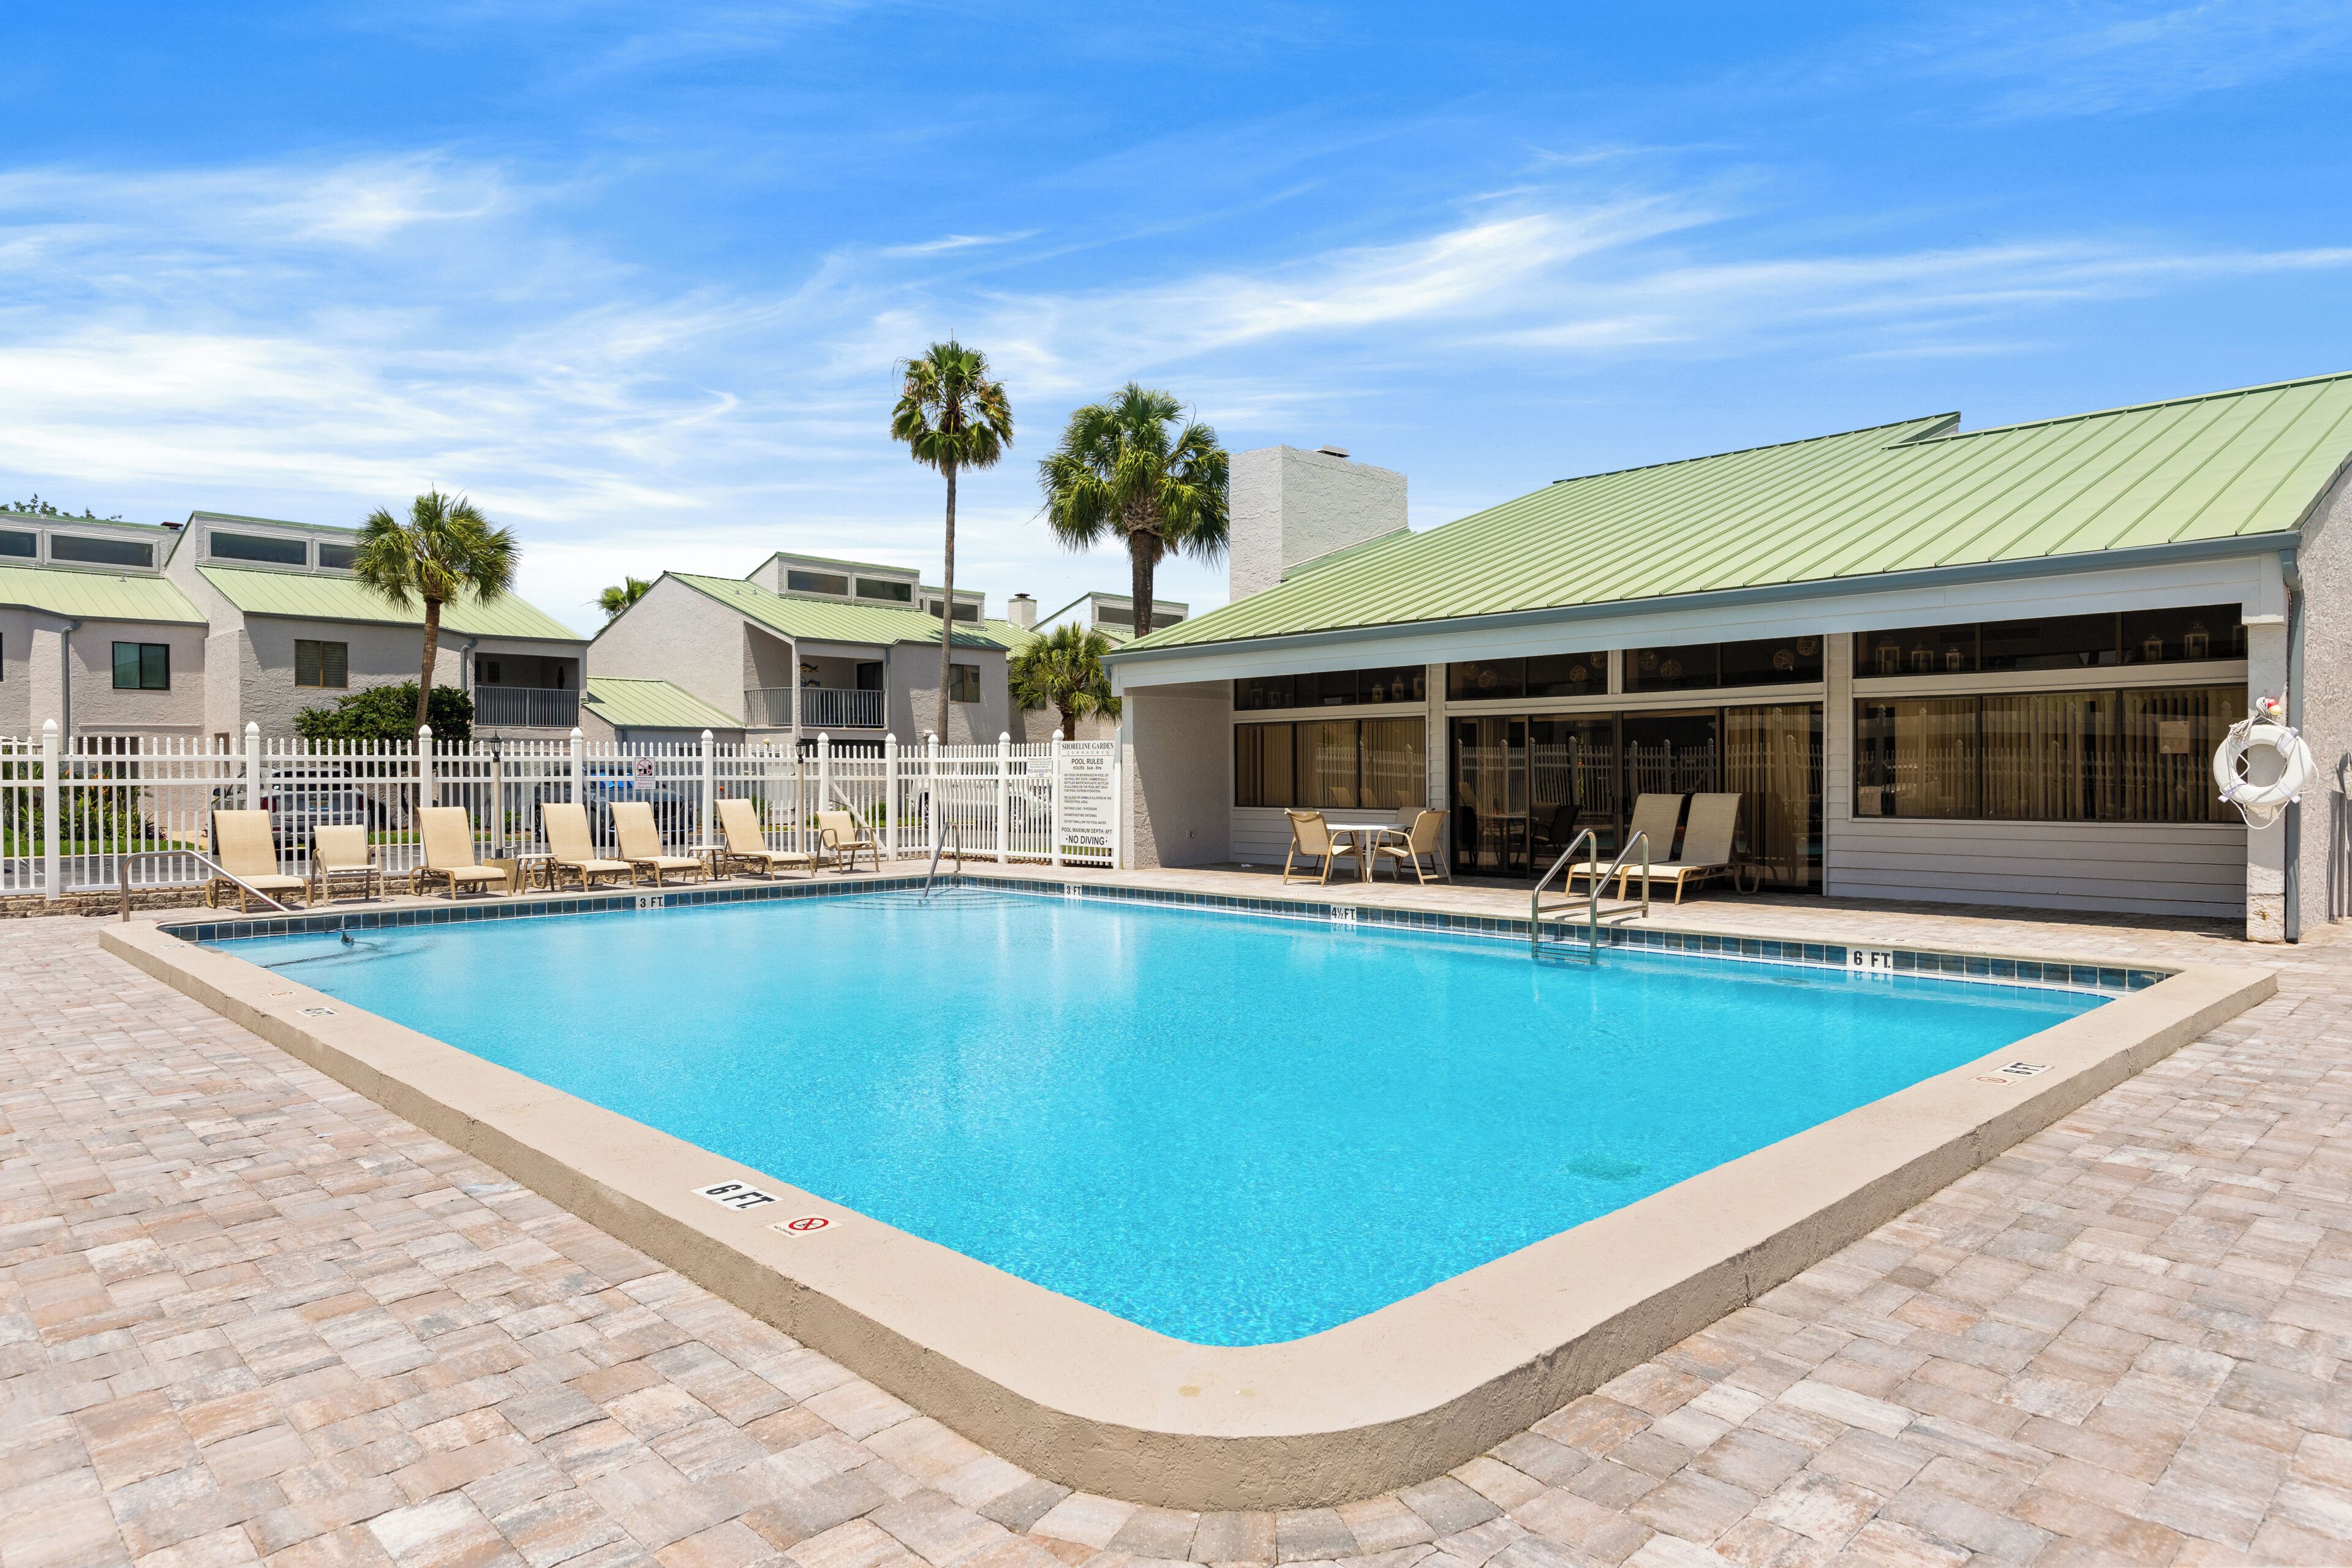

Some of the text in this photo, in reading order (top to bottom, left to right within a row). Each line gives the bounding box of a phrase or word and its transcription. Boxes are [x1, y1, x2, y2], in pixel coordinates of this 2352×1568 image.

[1080, 835, 1104, 845] DIVING
[1067, 886, 1071, 894] 3
[640, 897, 663, 908] 3 FT.
[1853, 951, 1891, 968] 6 FT.
[706, 1185, 775, 1209] 6 FT.
